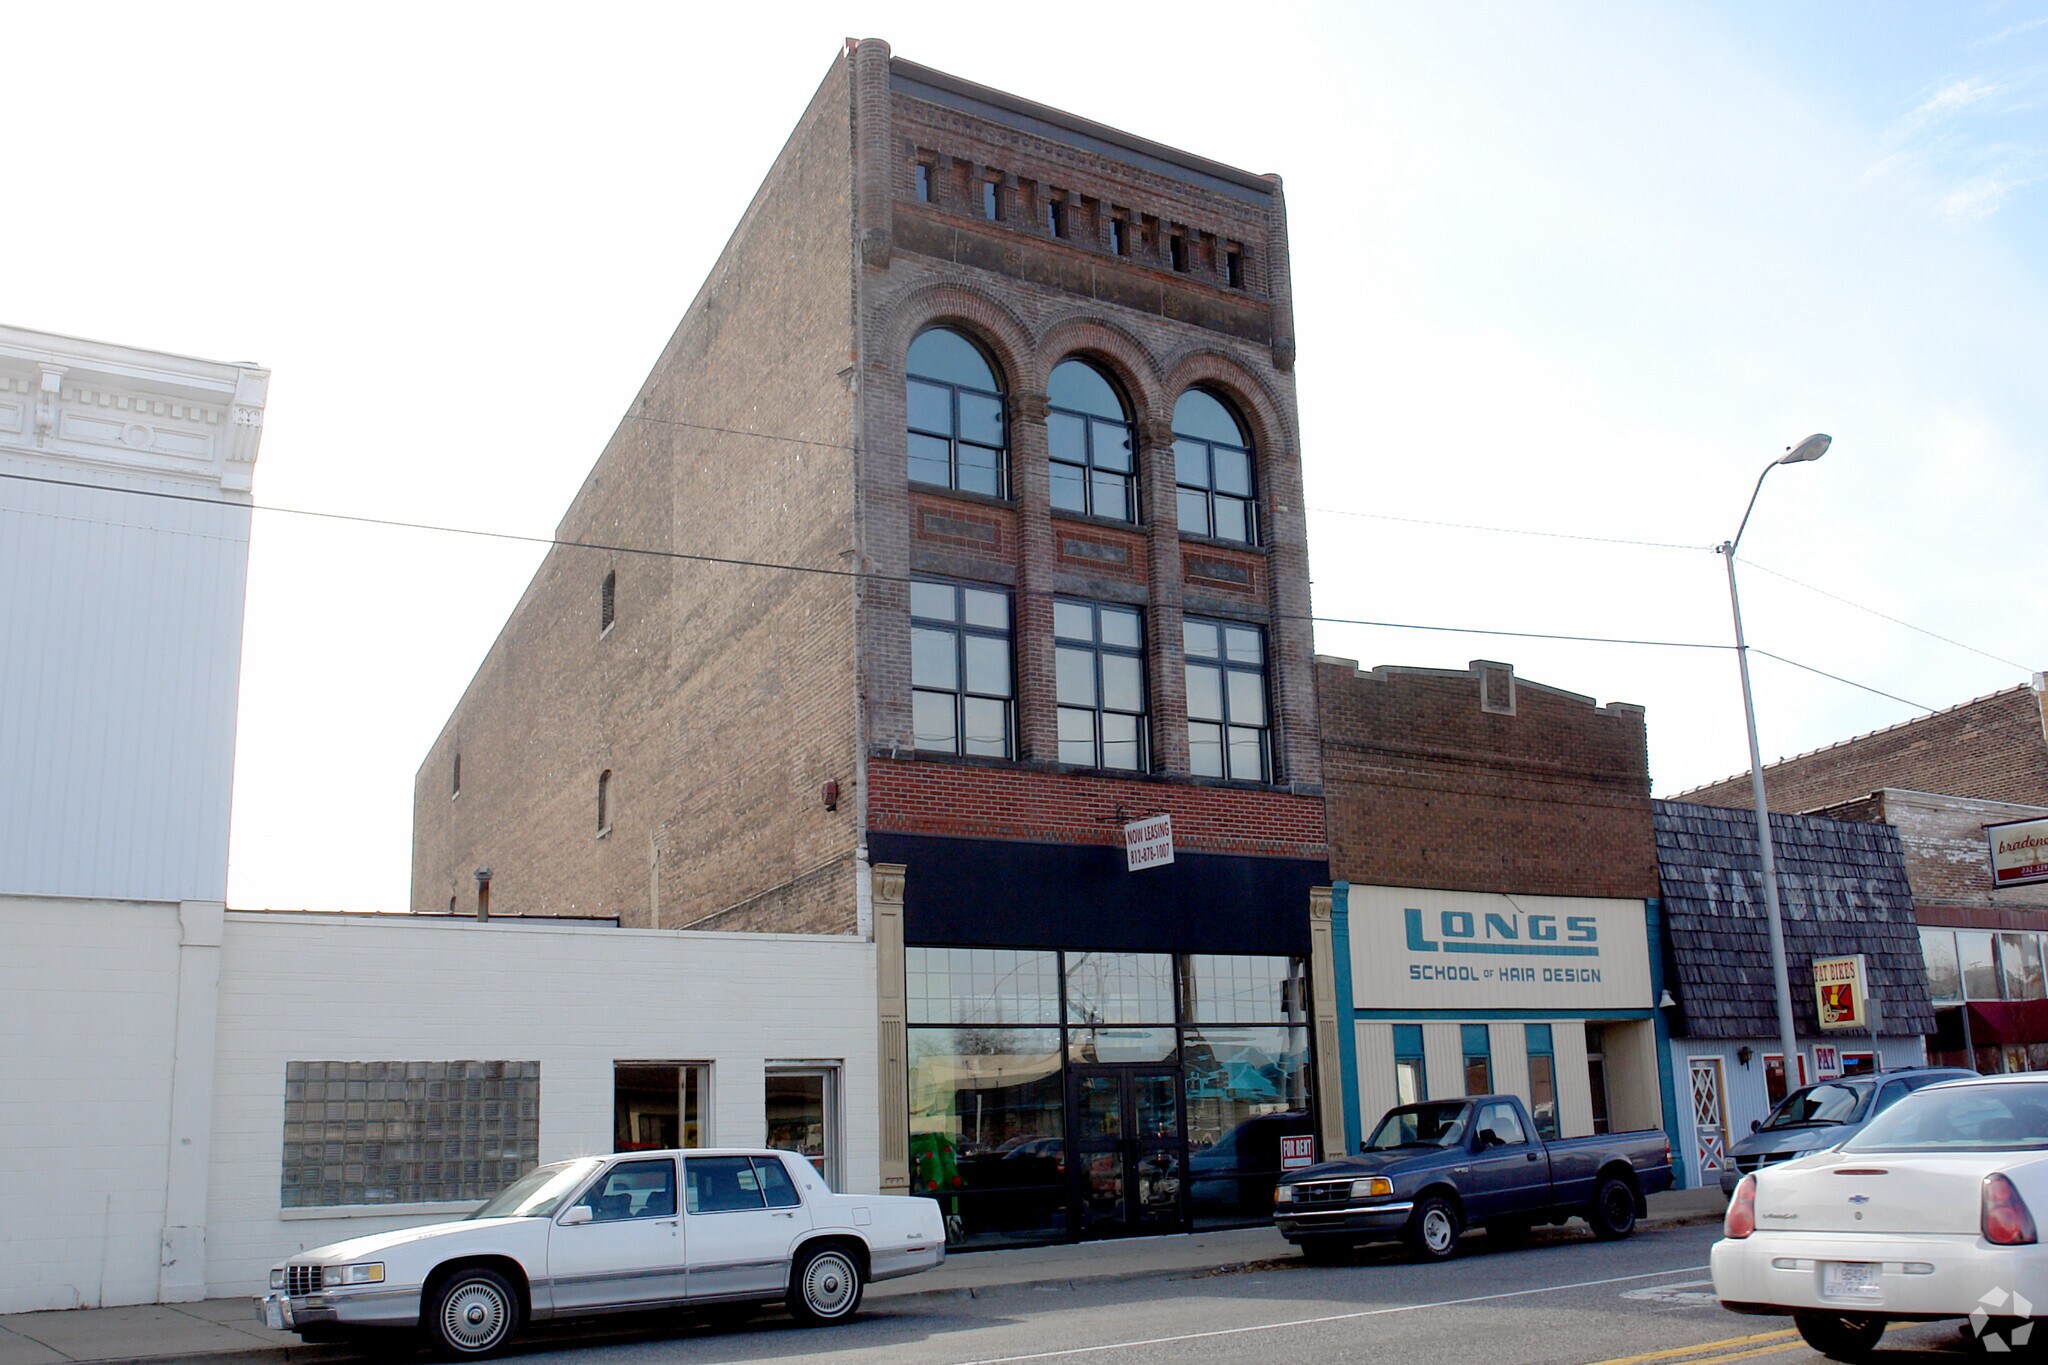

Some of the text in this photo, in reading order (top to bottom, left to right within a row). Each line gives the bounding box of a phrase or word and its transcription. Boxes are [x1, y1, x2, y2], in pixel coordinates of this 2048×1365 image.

[1127, 821, 1170, 845] NOW LEASING
[1404, 908, 1598, 952] LONGS
[1409, 964, 1601, 983] SCHOOL OF HAIR DESIGN
[1814, 961, 1855, 982] FAT BIKES
[1815, 1048, 1836, 1070] FAT
[1283, 1139, 1311, 1157] FOR RENT
